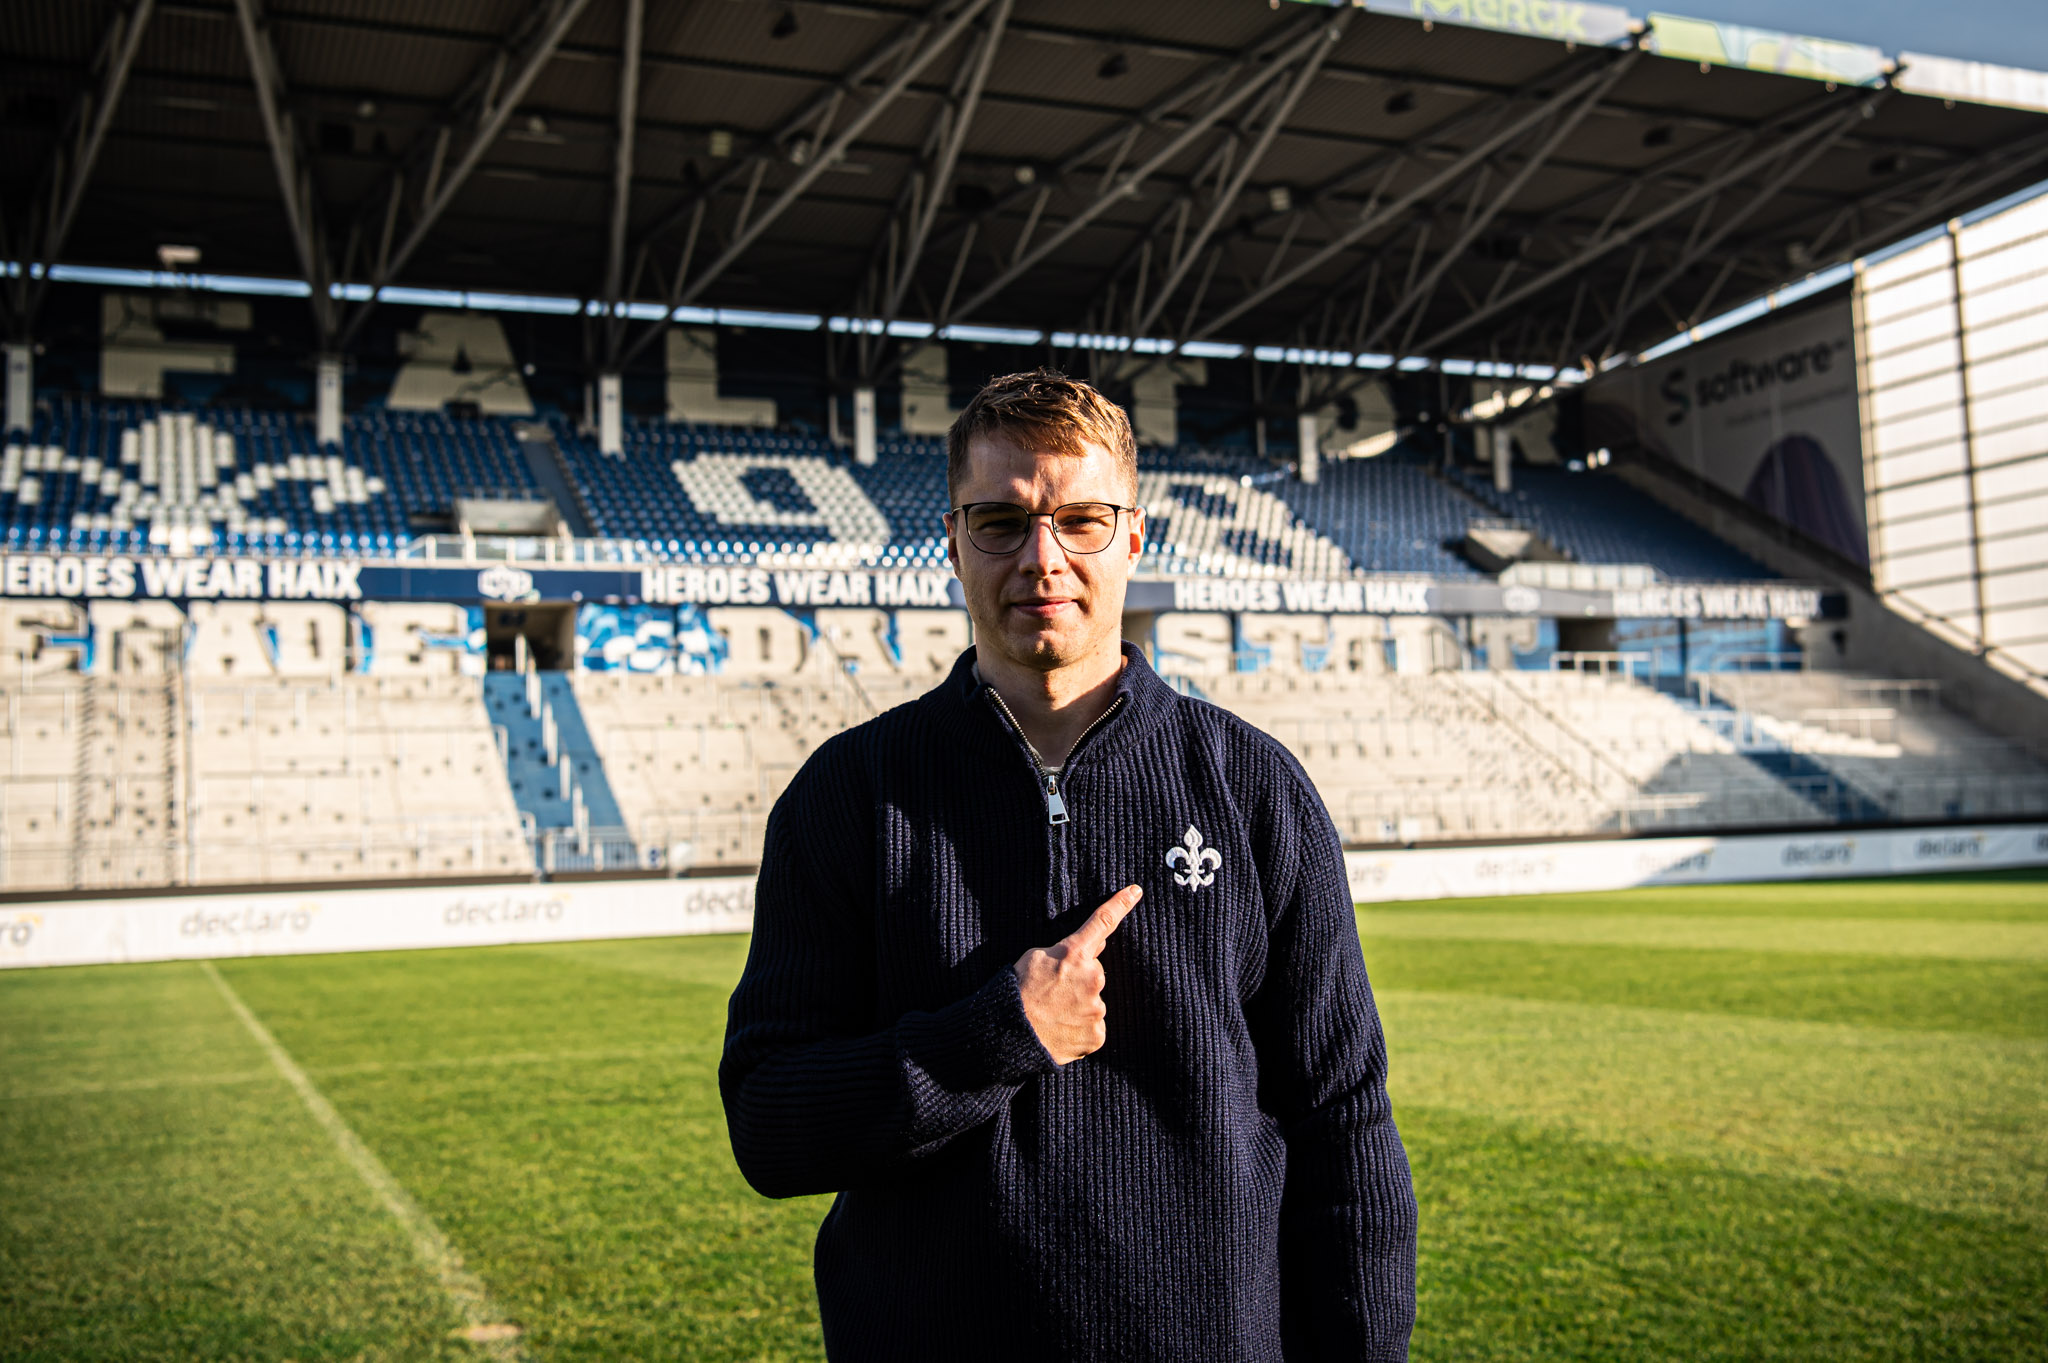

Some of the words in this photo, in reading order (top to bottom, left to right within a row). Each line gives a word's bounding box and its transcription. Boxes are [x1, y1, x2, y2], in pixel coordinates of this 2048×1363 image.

[0, 557, 136, 598] EROES
[141, 558, 263, 598] WEAR
[266, 561, 363, 599] HAIX
[641, 567, 771, 604] HEROES
[774, 569, 871, 605] WEAR
[875, 571, 951, 607] HAIX
[1174, 580, 1281, 612] HEROES
[1282, 581, 1364, 612] WEAR
[1365, 582, 1429, 613] HAIX
[442, 896, 565, 927] declaro
[685, 886, 756, 916] decl
[179, 905, 312, 939] declaro
